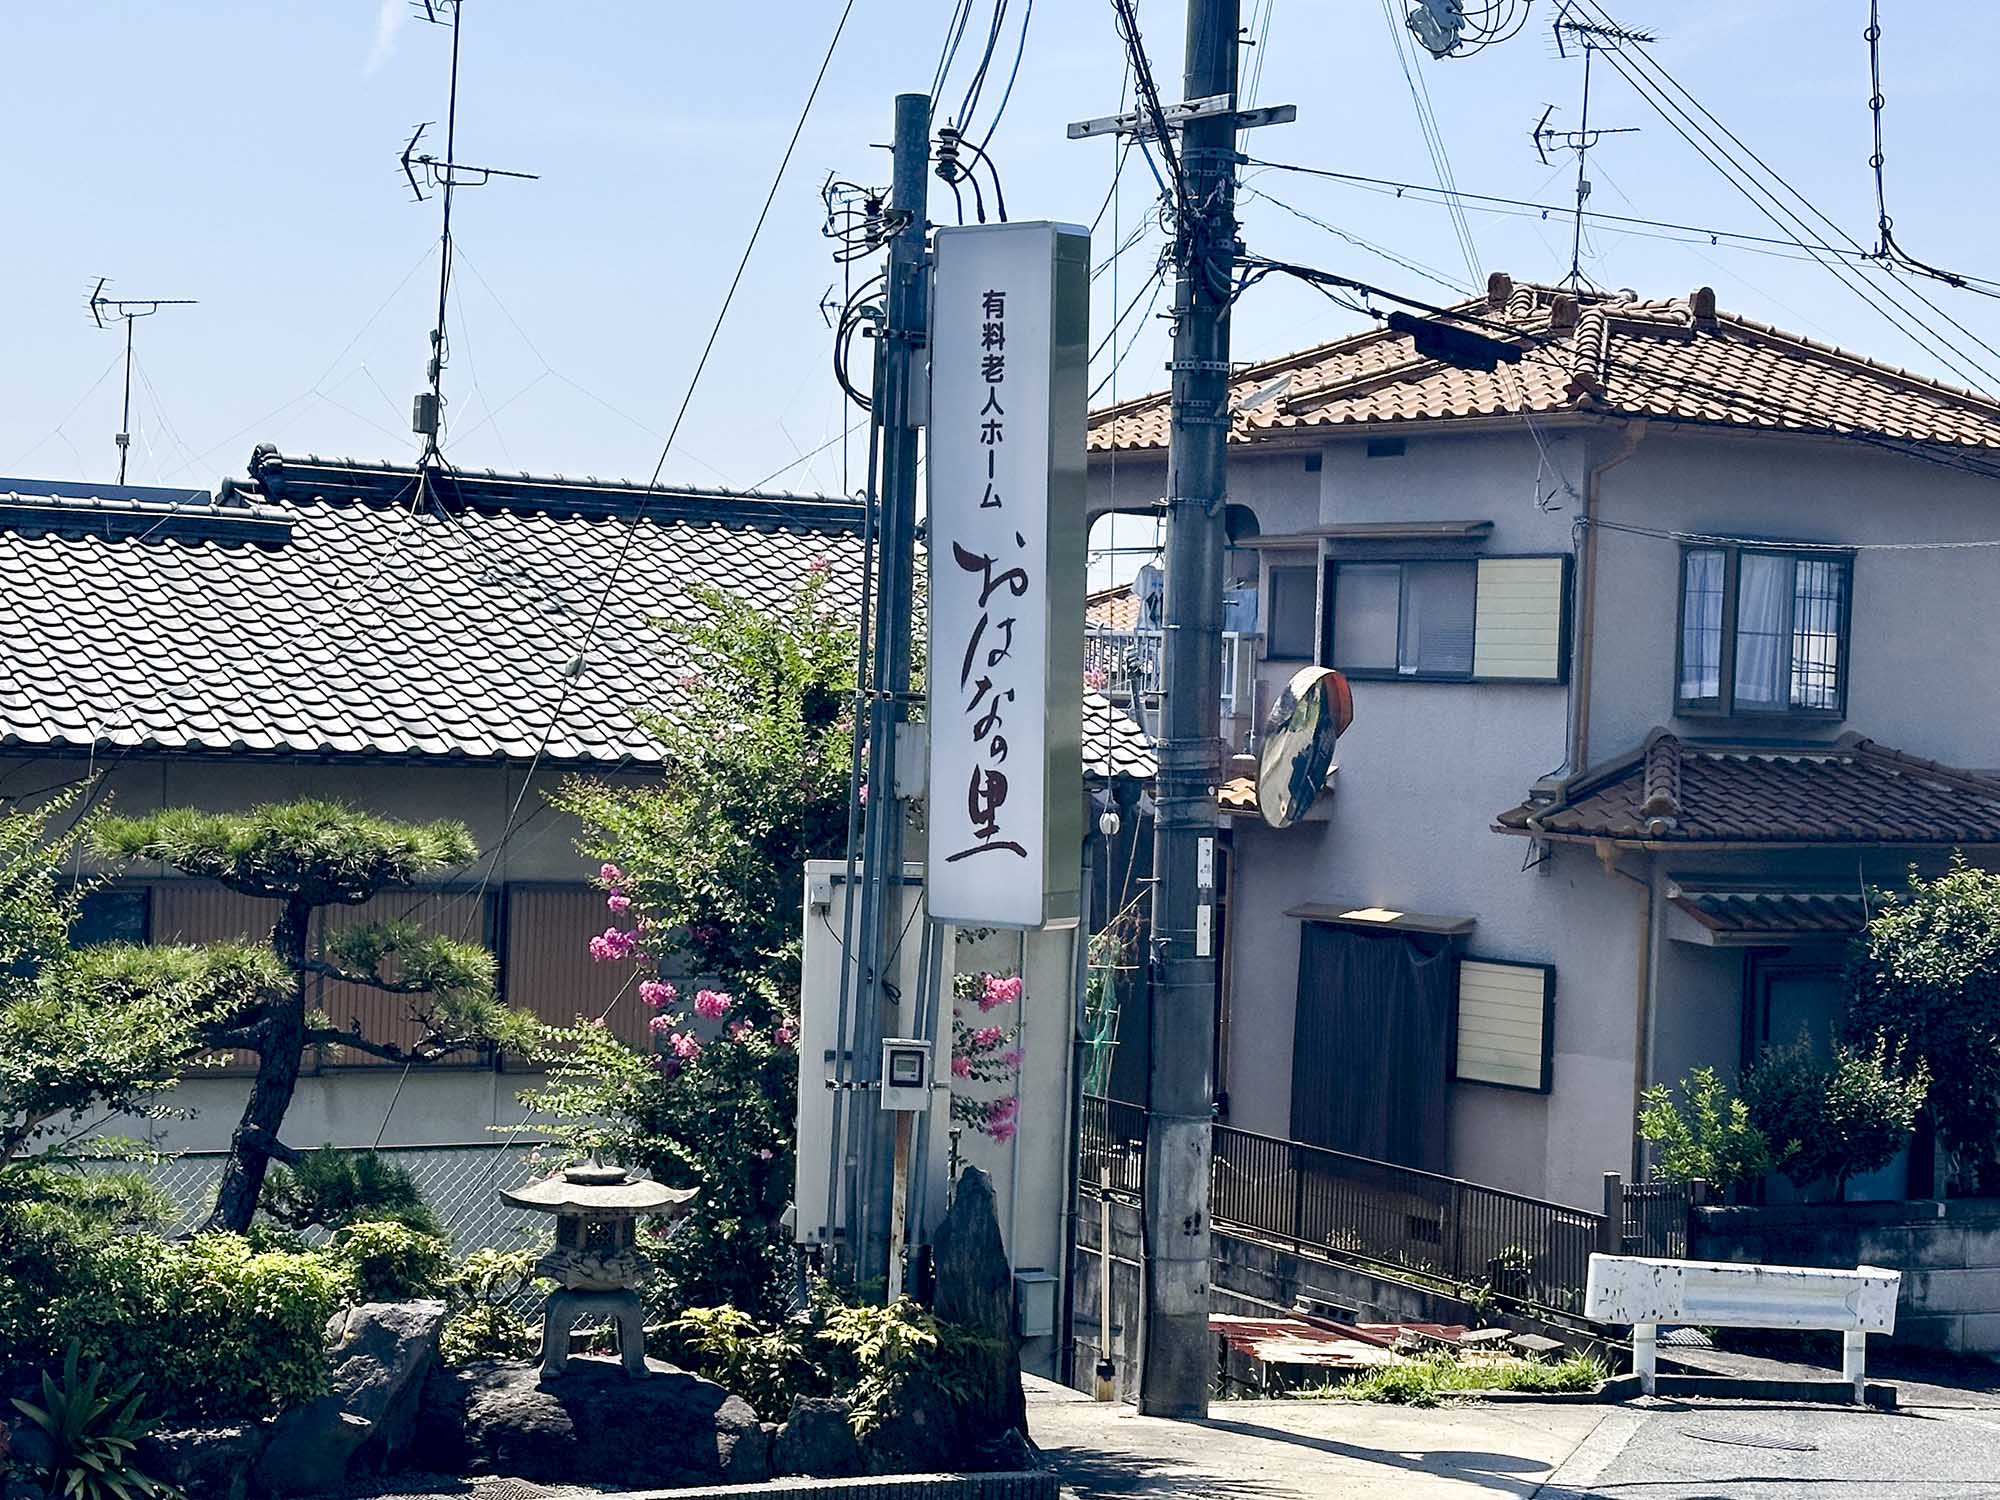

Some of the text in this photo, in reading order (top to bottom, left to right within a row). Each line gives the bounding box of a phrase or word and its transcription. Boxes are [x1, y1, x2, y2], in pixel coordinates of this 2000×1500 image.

[980, 289, 1006, 509] 有料老人ホーム
[945, 531, 1029, 862] おはなの里
